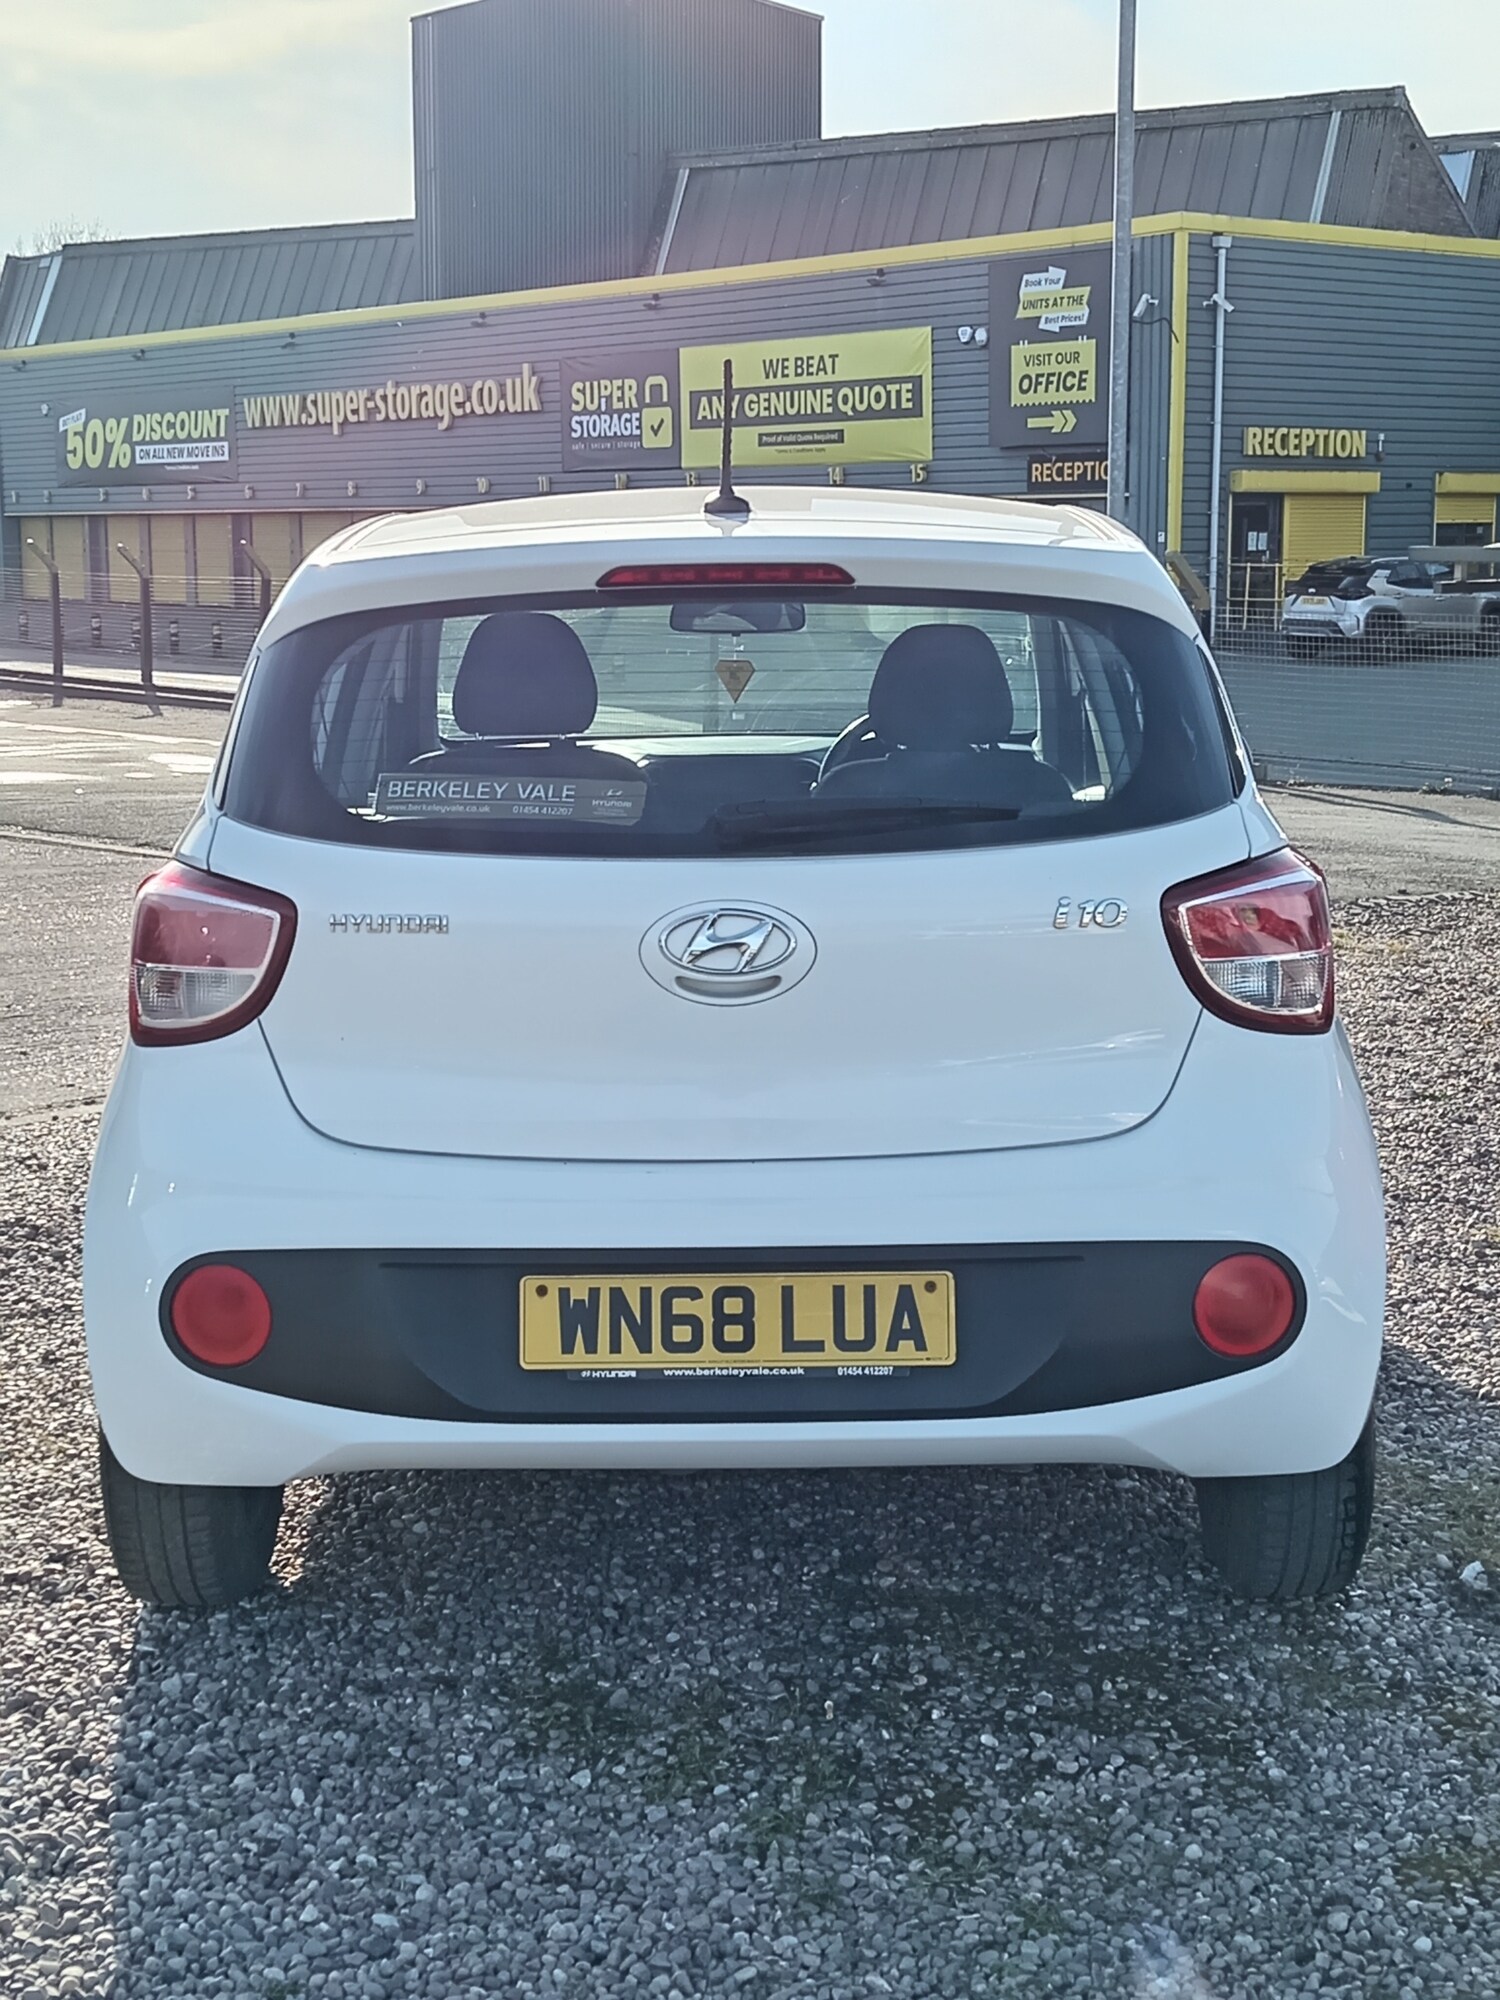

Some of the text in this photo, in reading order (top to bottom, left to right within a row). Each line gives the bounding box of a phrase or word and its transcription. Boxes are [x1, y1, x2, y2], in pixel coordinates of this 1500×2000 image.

[1024, 277, 1061, 288] Book Your
[1022, 294, 1085, 311] UNITS AT THE
[1044, 313, 1085, 325] Best Prices!
[762, 354, 839, 380] WE BEAT
[1024, 351, 1080, 367] VISIT OUR
[1018, 370, 1089, 395] OFFICE
[243, 363, 542, 435] www.super-storage.co.uk
[571, 378, 638, 412] SUPER
[697, 382, 913, 421] ANY GENUINE QUOTE
[132, 408, 229, 442] DISCOUNT
[571, 412, 641, 438] STORAGE
[66, 417, 131, 470] 50%
[617, 440, 641, 450] storage
[762, 435, 776, 443] Proof
[1243, 427, 1366, 458] RECEPTION
[139, 445, 225, 460] ON ALL NEW MOVE INS
[828, 466, 843, 485] 14
[910, 463, 927, 484] 15
[1031, 461, 1109, 483] RECEPTIO
[187, 485, 196, 500] 5
[347, 480, 357, 497] 8
[416, 479, 426, 495] 9
[476, 477, 490, 494] 10
[538, 475, 550, 493] 11
[387, 780, 576, 802] BERKELEY VALE
[386, 803, 574, 816] www.berkeleyvale.co.uk 01454 412207
[1053, 896, 1128, 929] i10
[328, 913, 449, 934] HYUNDAI
[558, 1283, 929, 1355] WN68 LUA
[591, 1370, 637, 1378] HYUNDAI
[663, 1366, 805, 1378] www.berkeleyvale.co.uk
[837, 1366, 894, 1376] 01454 412207
